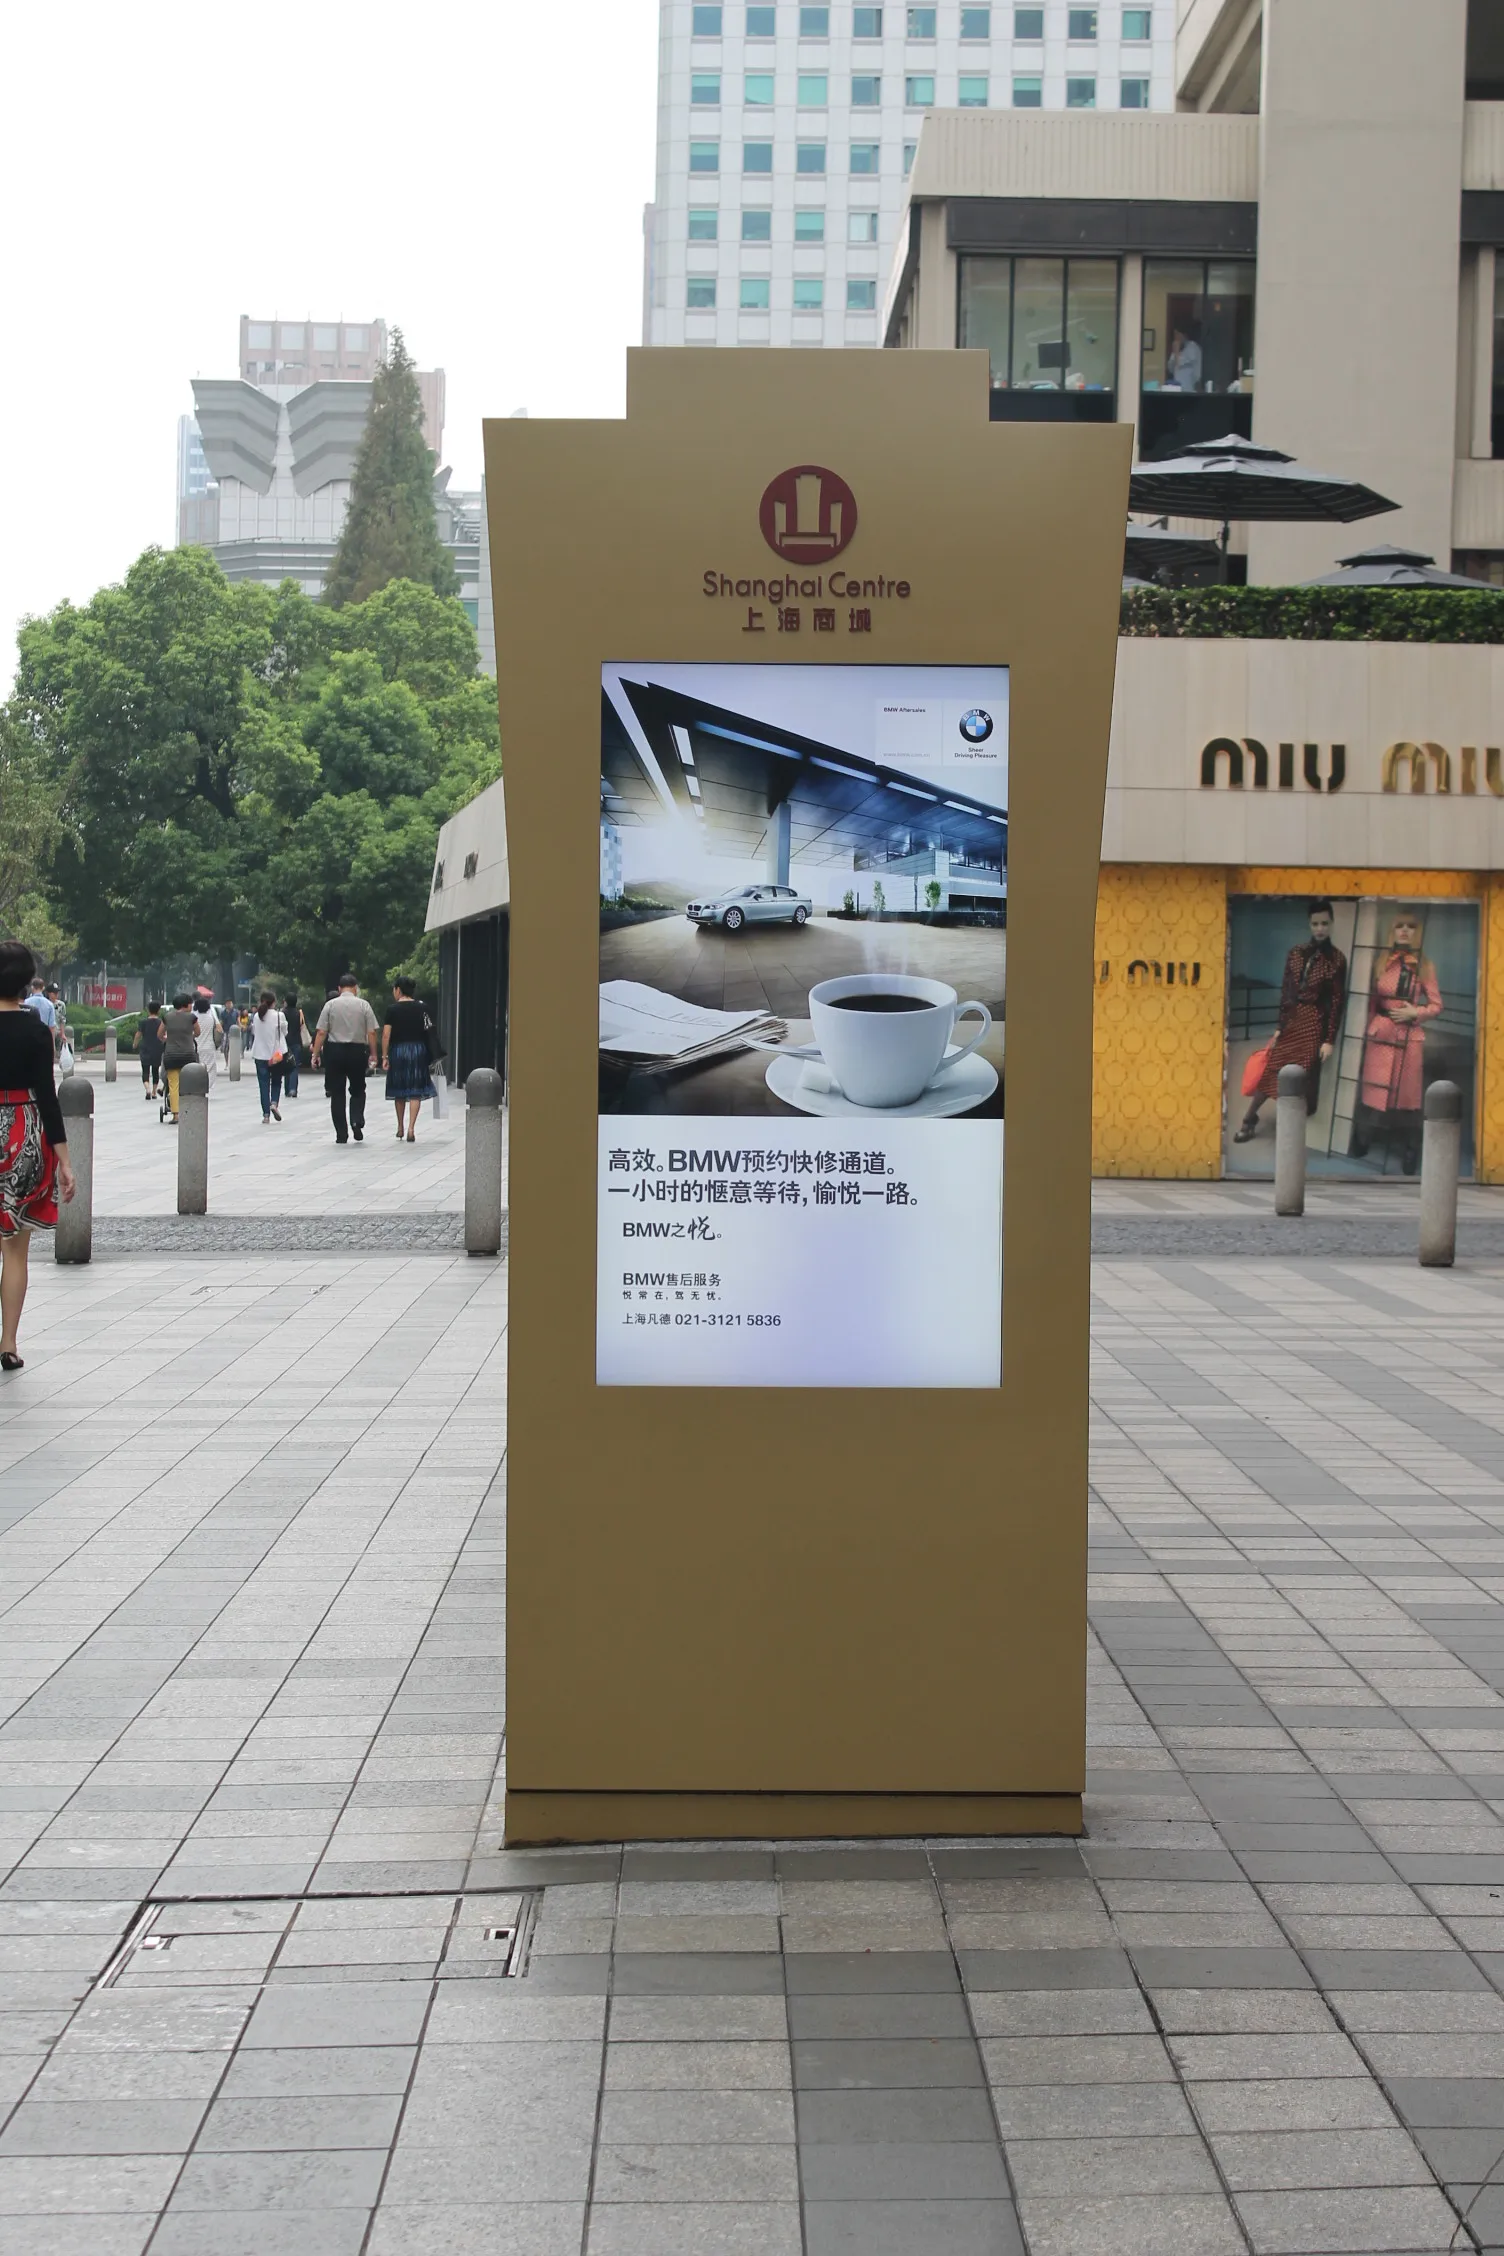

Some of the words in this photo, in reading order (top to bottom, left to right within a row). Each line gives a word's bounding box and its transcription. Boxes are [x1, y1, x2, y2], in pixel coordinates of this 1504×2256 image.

[702, 570, 823, 604] Shanghai
[828, 571, 911, 599] Centre
[741, 606, 872, 633] 上海商城
[622, 1272, 722, 1287] BMW售后服务
[674, 1313, 742, 1326] 021-3121
[746, 1314, 782, 1327] 5836
